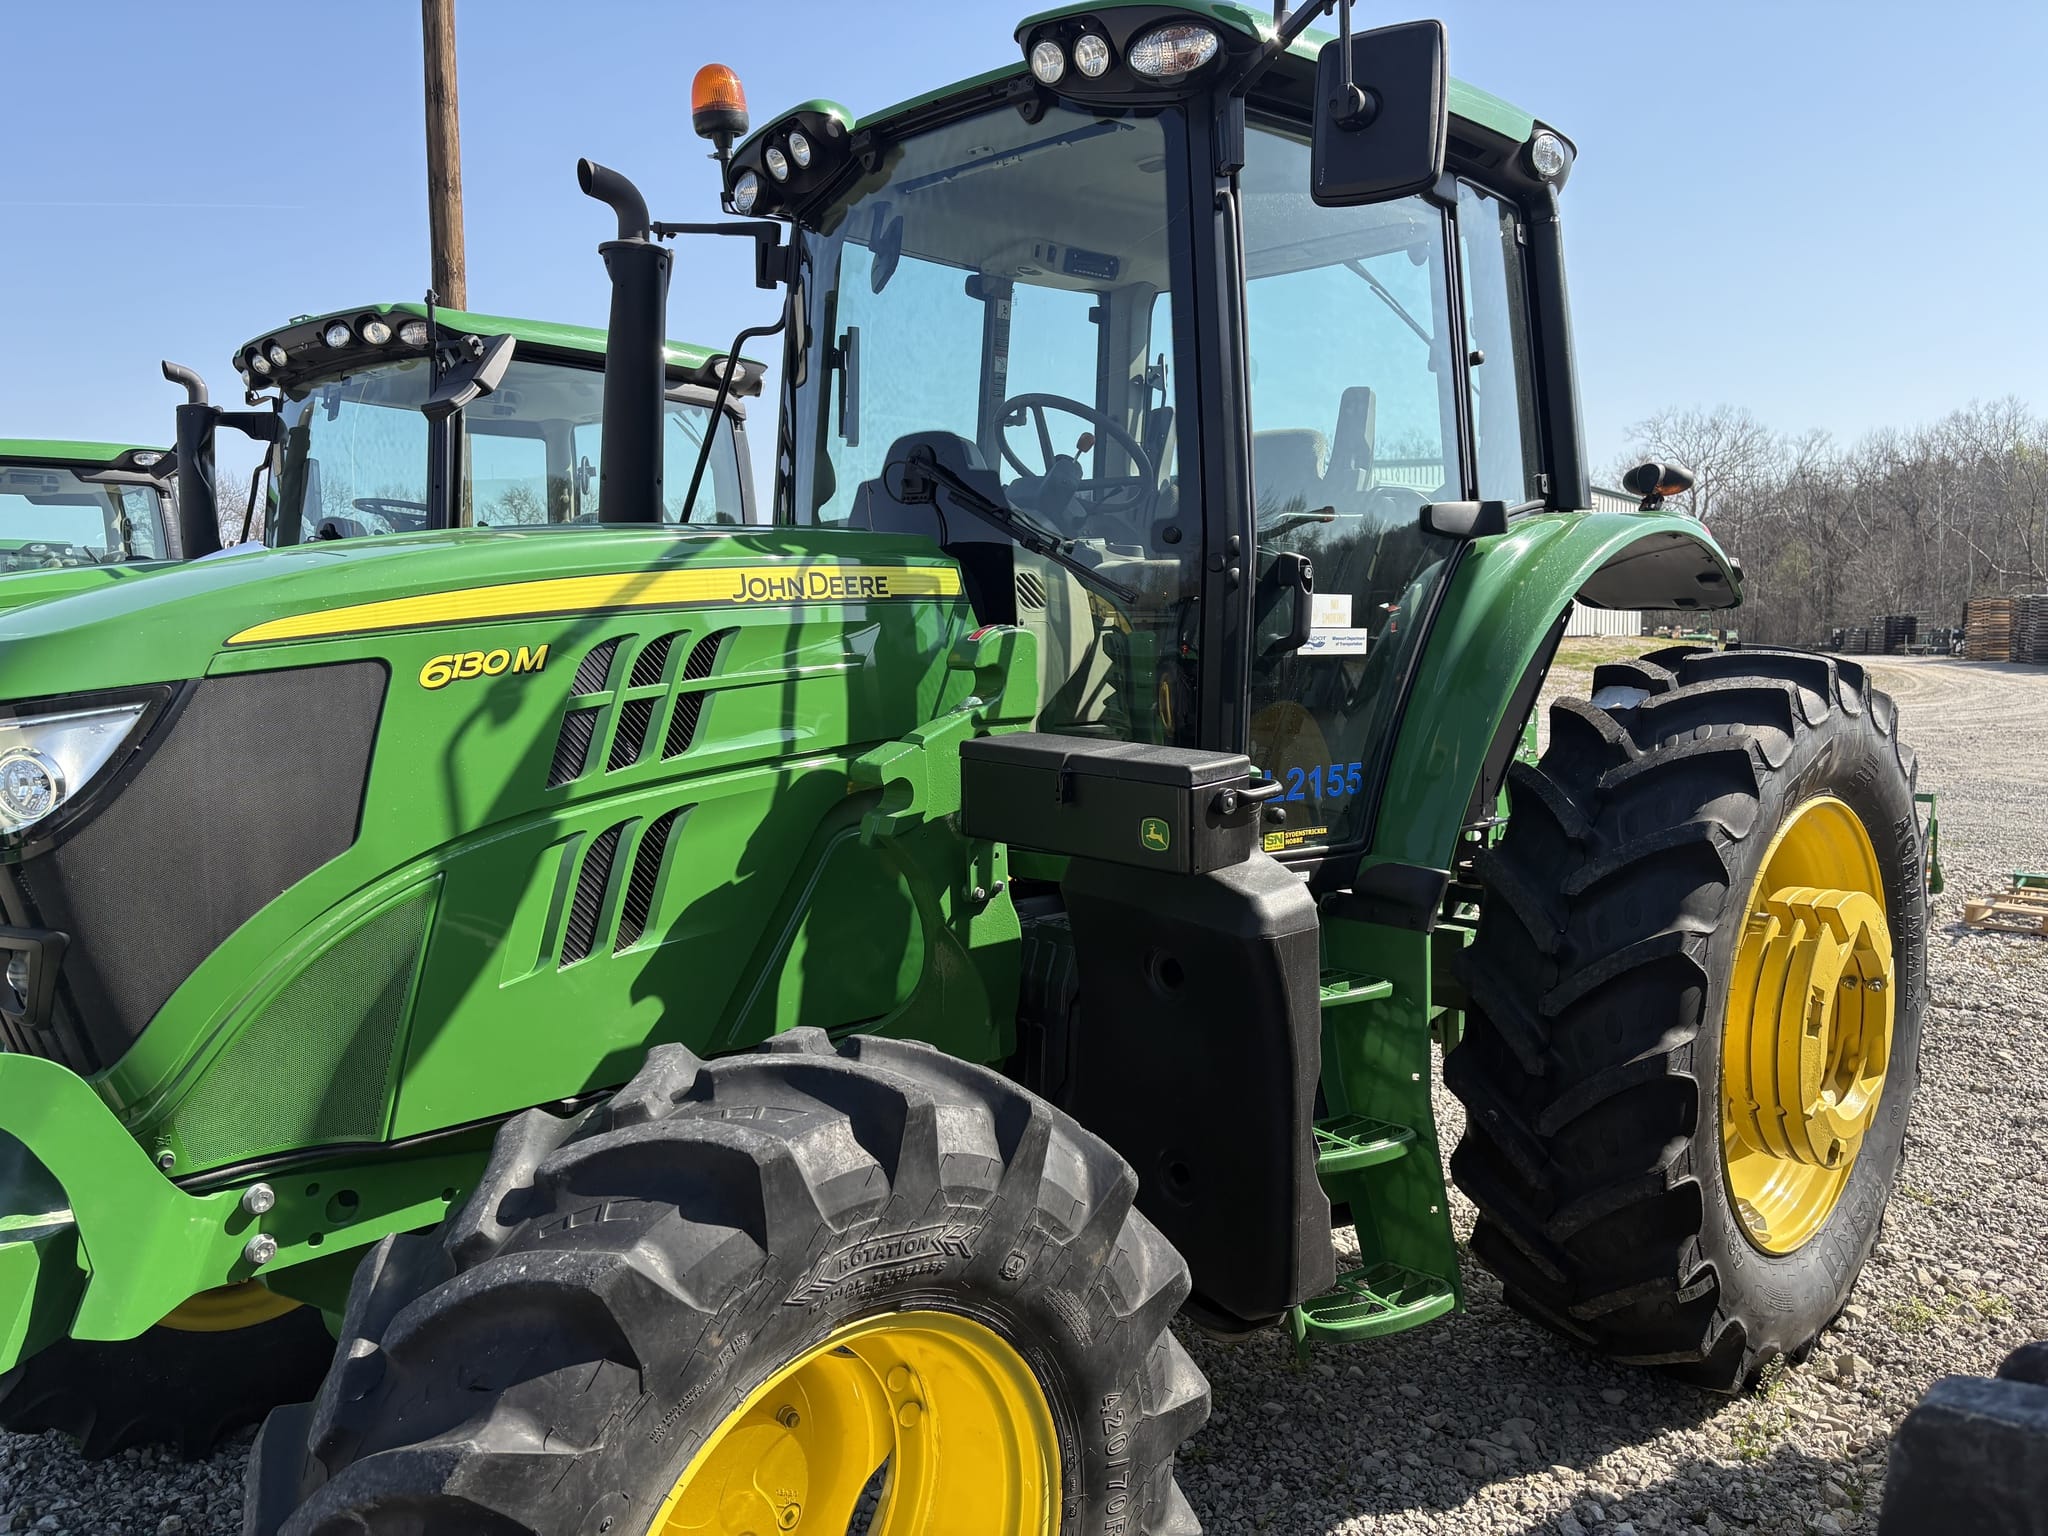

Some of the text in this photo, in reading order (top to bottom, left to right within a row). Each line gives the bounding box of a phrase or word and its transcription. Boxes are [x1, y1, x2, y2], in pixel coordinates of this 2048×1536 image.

[733, 572, 889, 599] JOHN DEERE
[1285, 827, 1328, 839] SYDENSTRICKER
[1285, 837, 1304, 845] NOBBE
[838, 1235, 931, 1273] ROTATION
